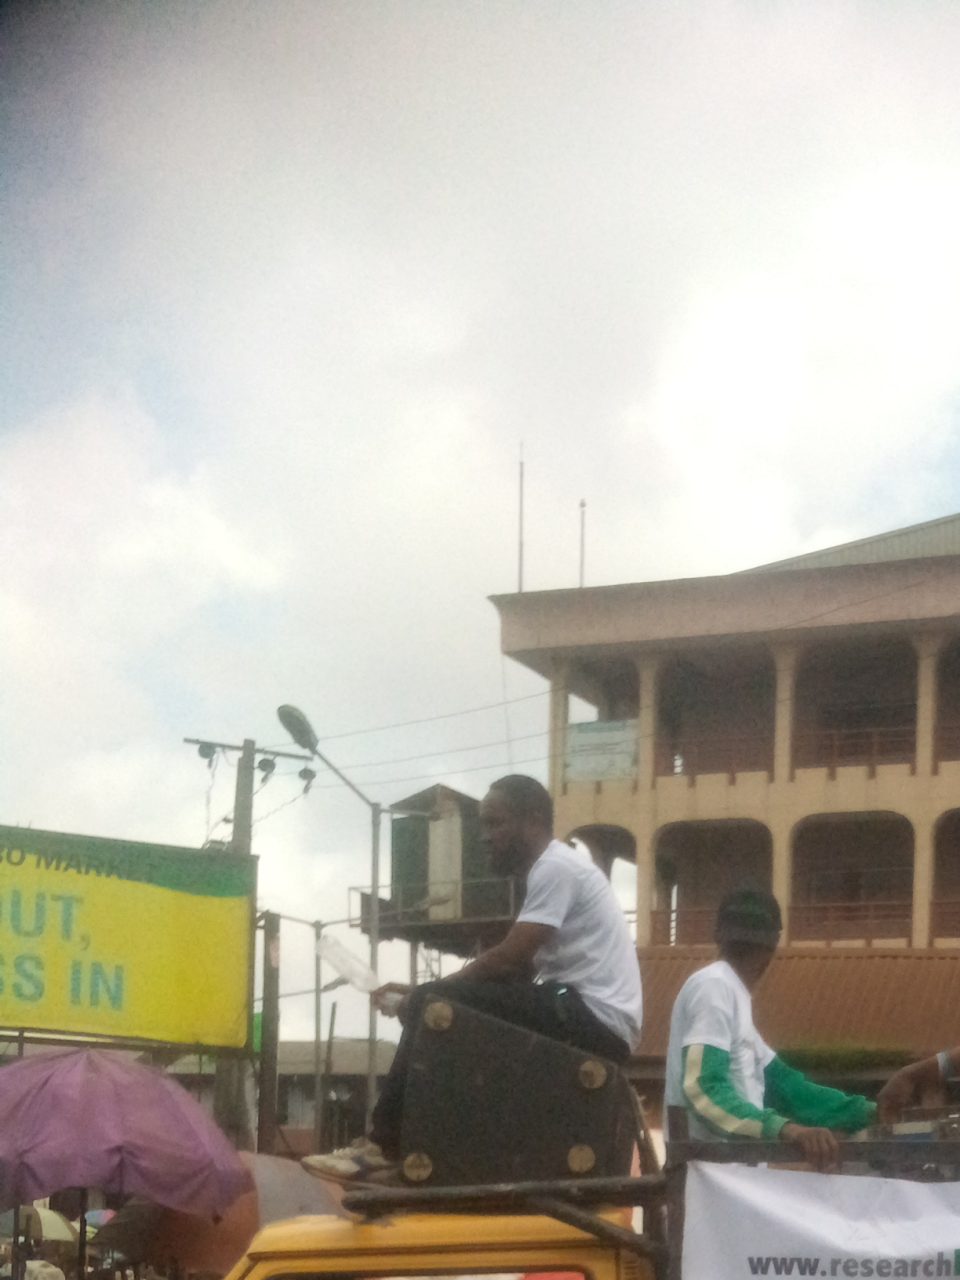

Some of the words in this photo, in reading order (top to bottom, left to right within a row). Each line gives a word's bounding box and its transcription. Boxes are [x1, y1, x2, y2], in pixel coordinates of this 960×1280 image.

[0, 845, 25, 866] O
[0, 887, 89, 950] UT,
[0, 953, 45, 1003] S
[69, 958, 124, 1010] IN
